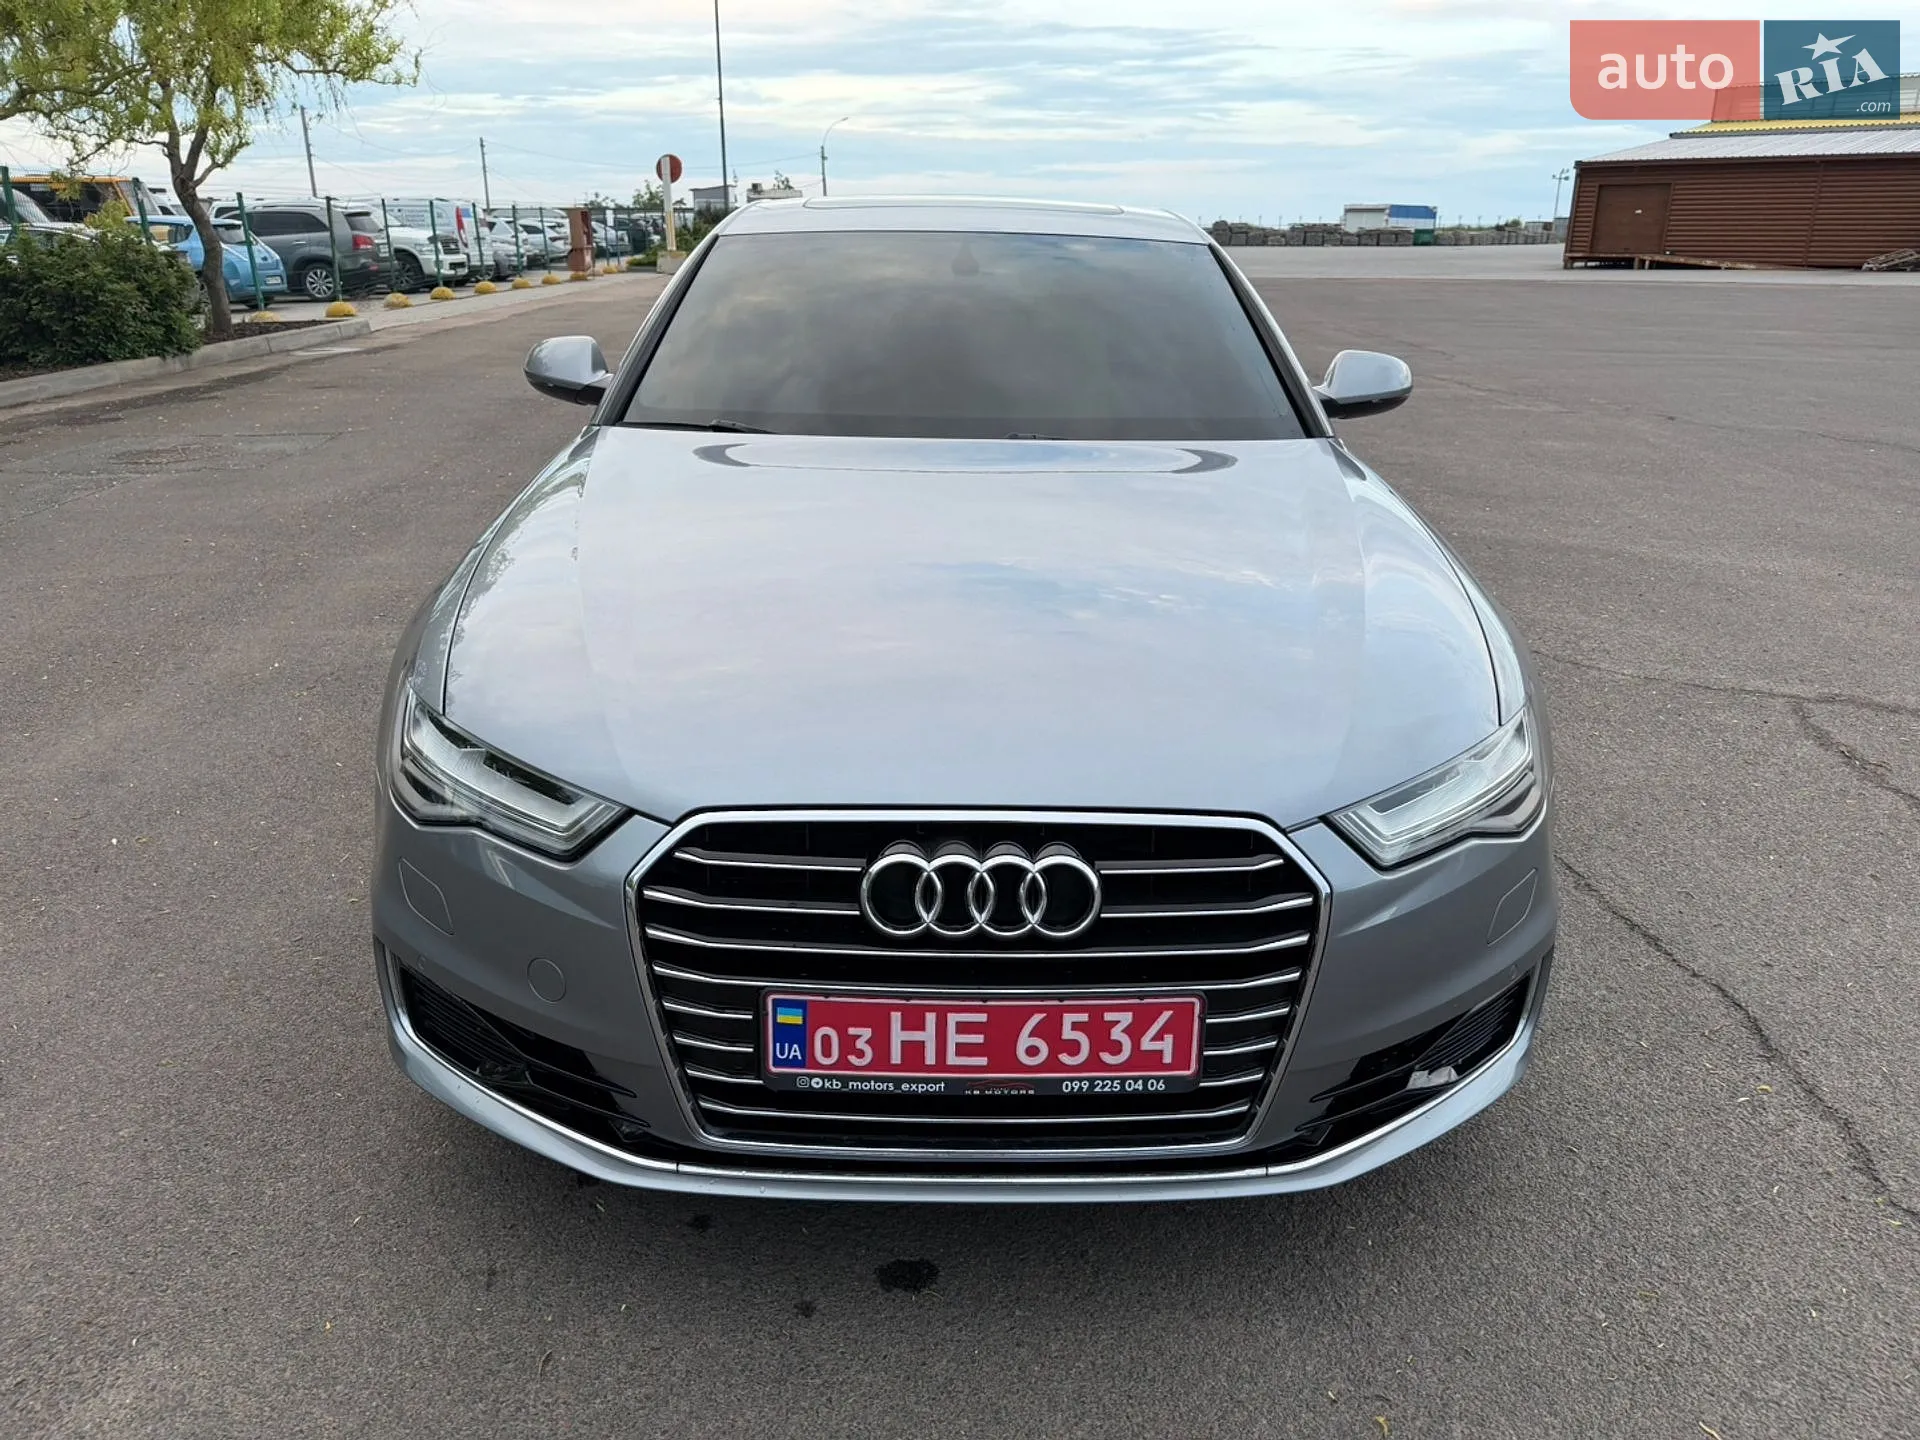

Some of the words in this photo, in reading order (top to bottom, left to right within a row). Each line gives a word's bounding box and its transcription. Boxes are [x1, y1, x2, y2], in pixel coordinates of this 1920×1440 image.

[813, 1026, 874, 1066] 03
[890, 1010, 989, 1066] HE
[1015, 1009, 1175, 1066] 6534
[775, 1043, 802, 1061] UA
[824, 1078, 945, 1094] kb_motors_export
[1062, 1080, 1089, 1093] 099
[1093, 1079, 1121, 1092] 225
[1125, 1079, 1143, 1091] 04
[1147, 1078, 1166, 1091] 06
